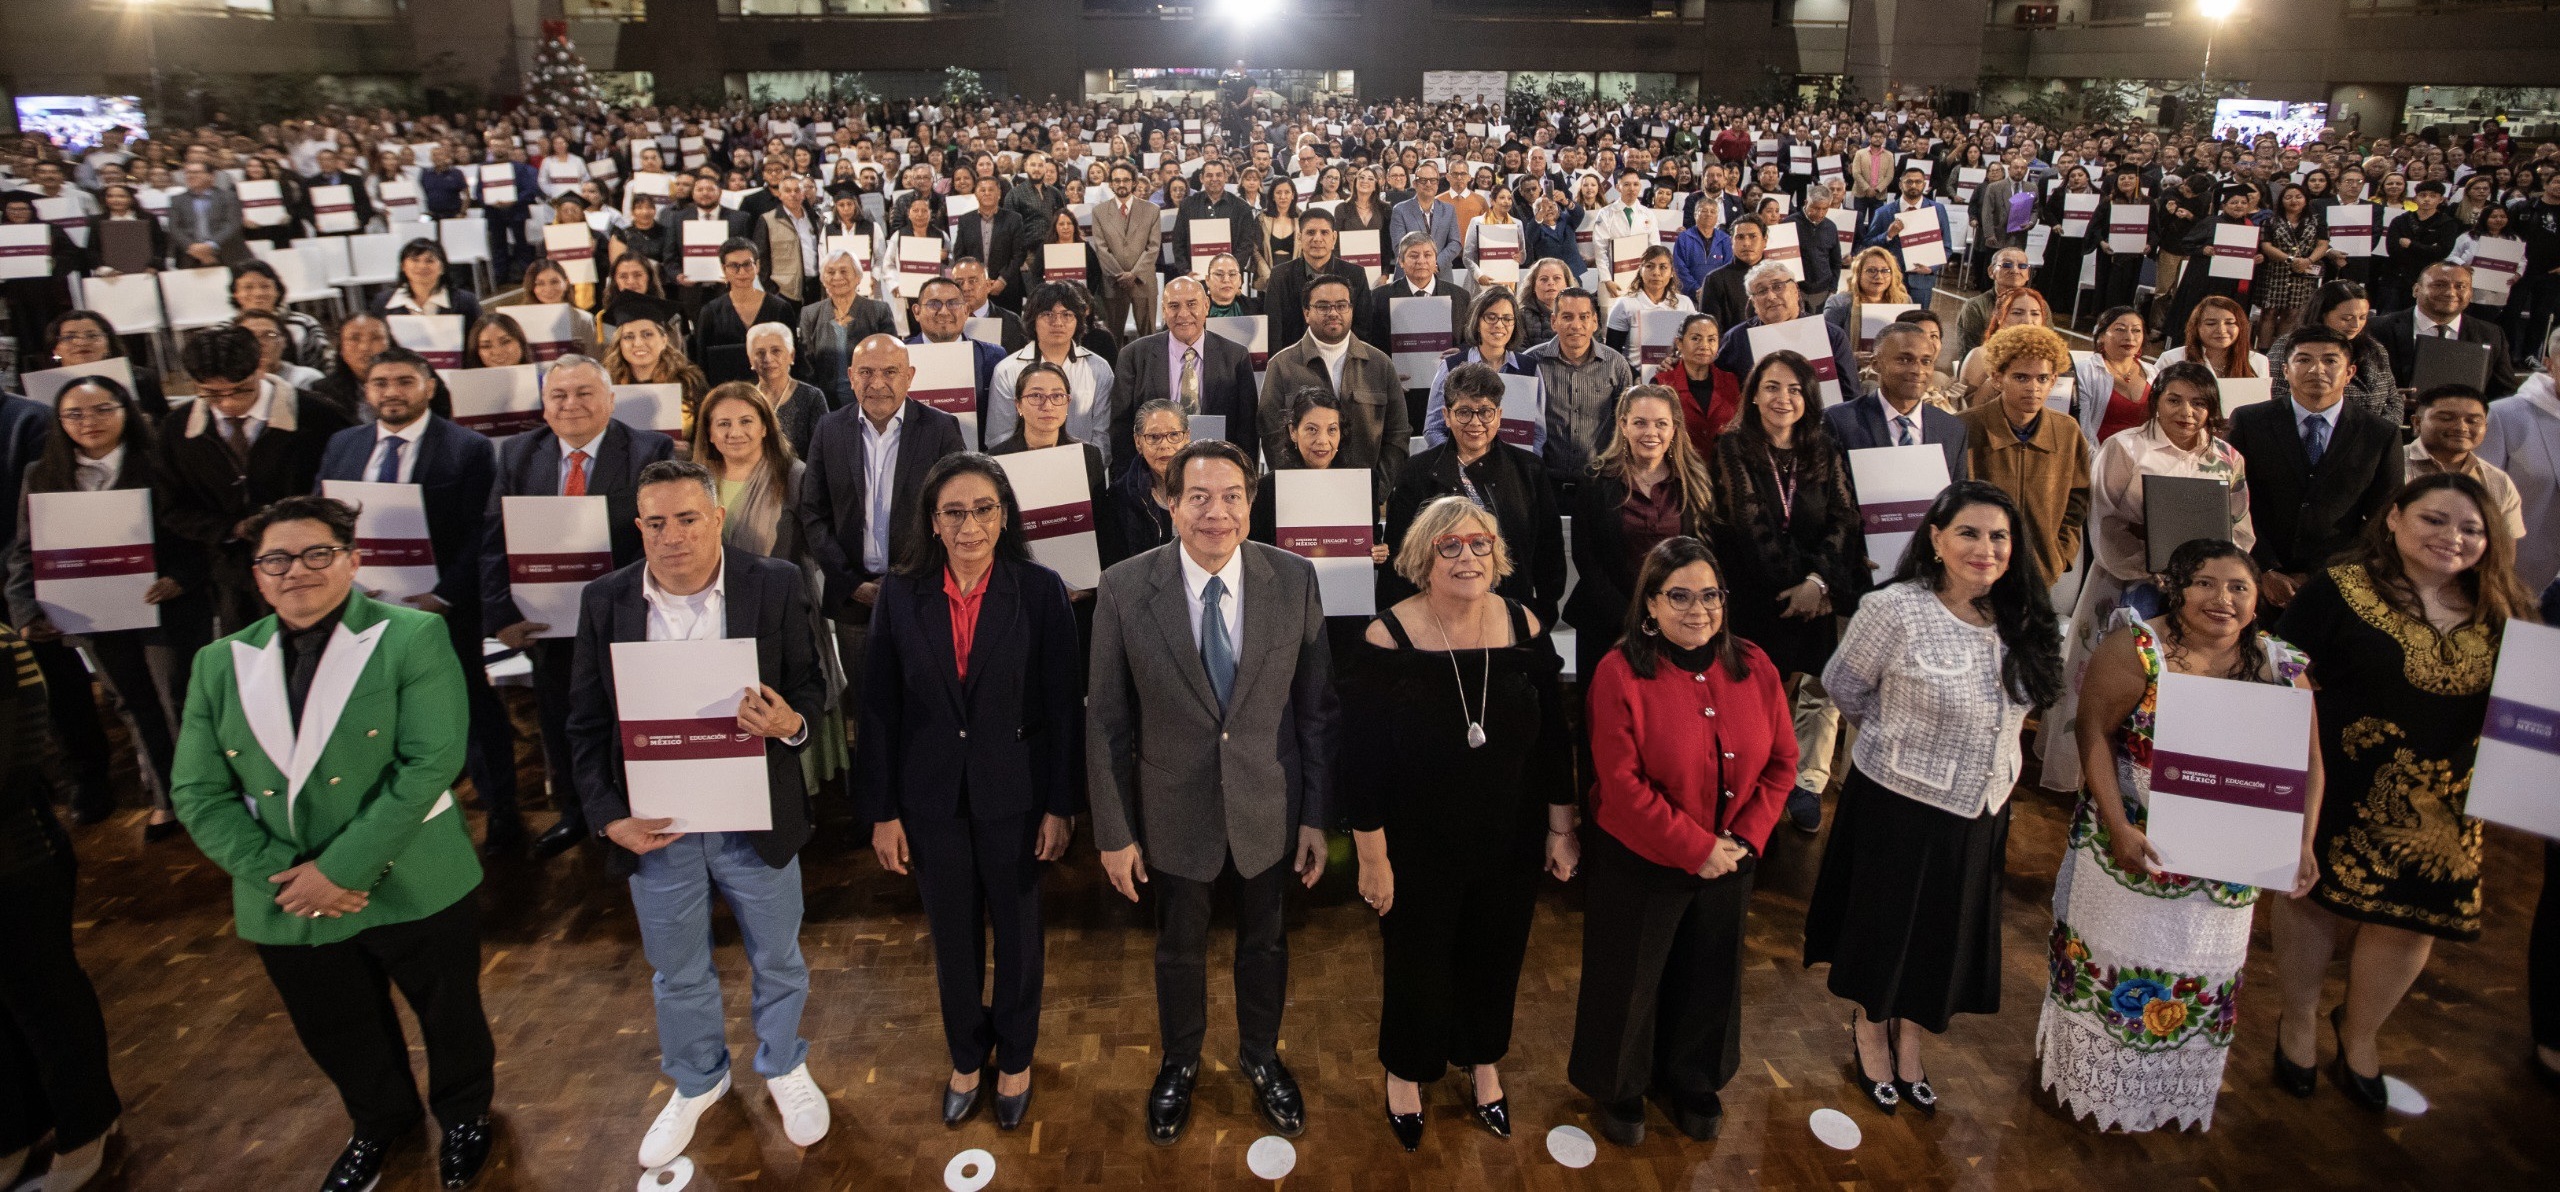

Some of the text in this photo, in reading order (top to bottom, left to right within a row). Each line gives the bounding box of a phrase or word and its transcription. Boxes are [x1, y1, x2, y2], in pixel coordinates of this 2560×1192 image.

[2182, 770, 2208, 778] GOBIERNO
[2182, 774, 2217, 785] MÉXICO
[2225, 777, 2266, 788] EDUCACIÓN
